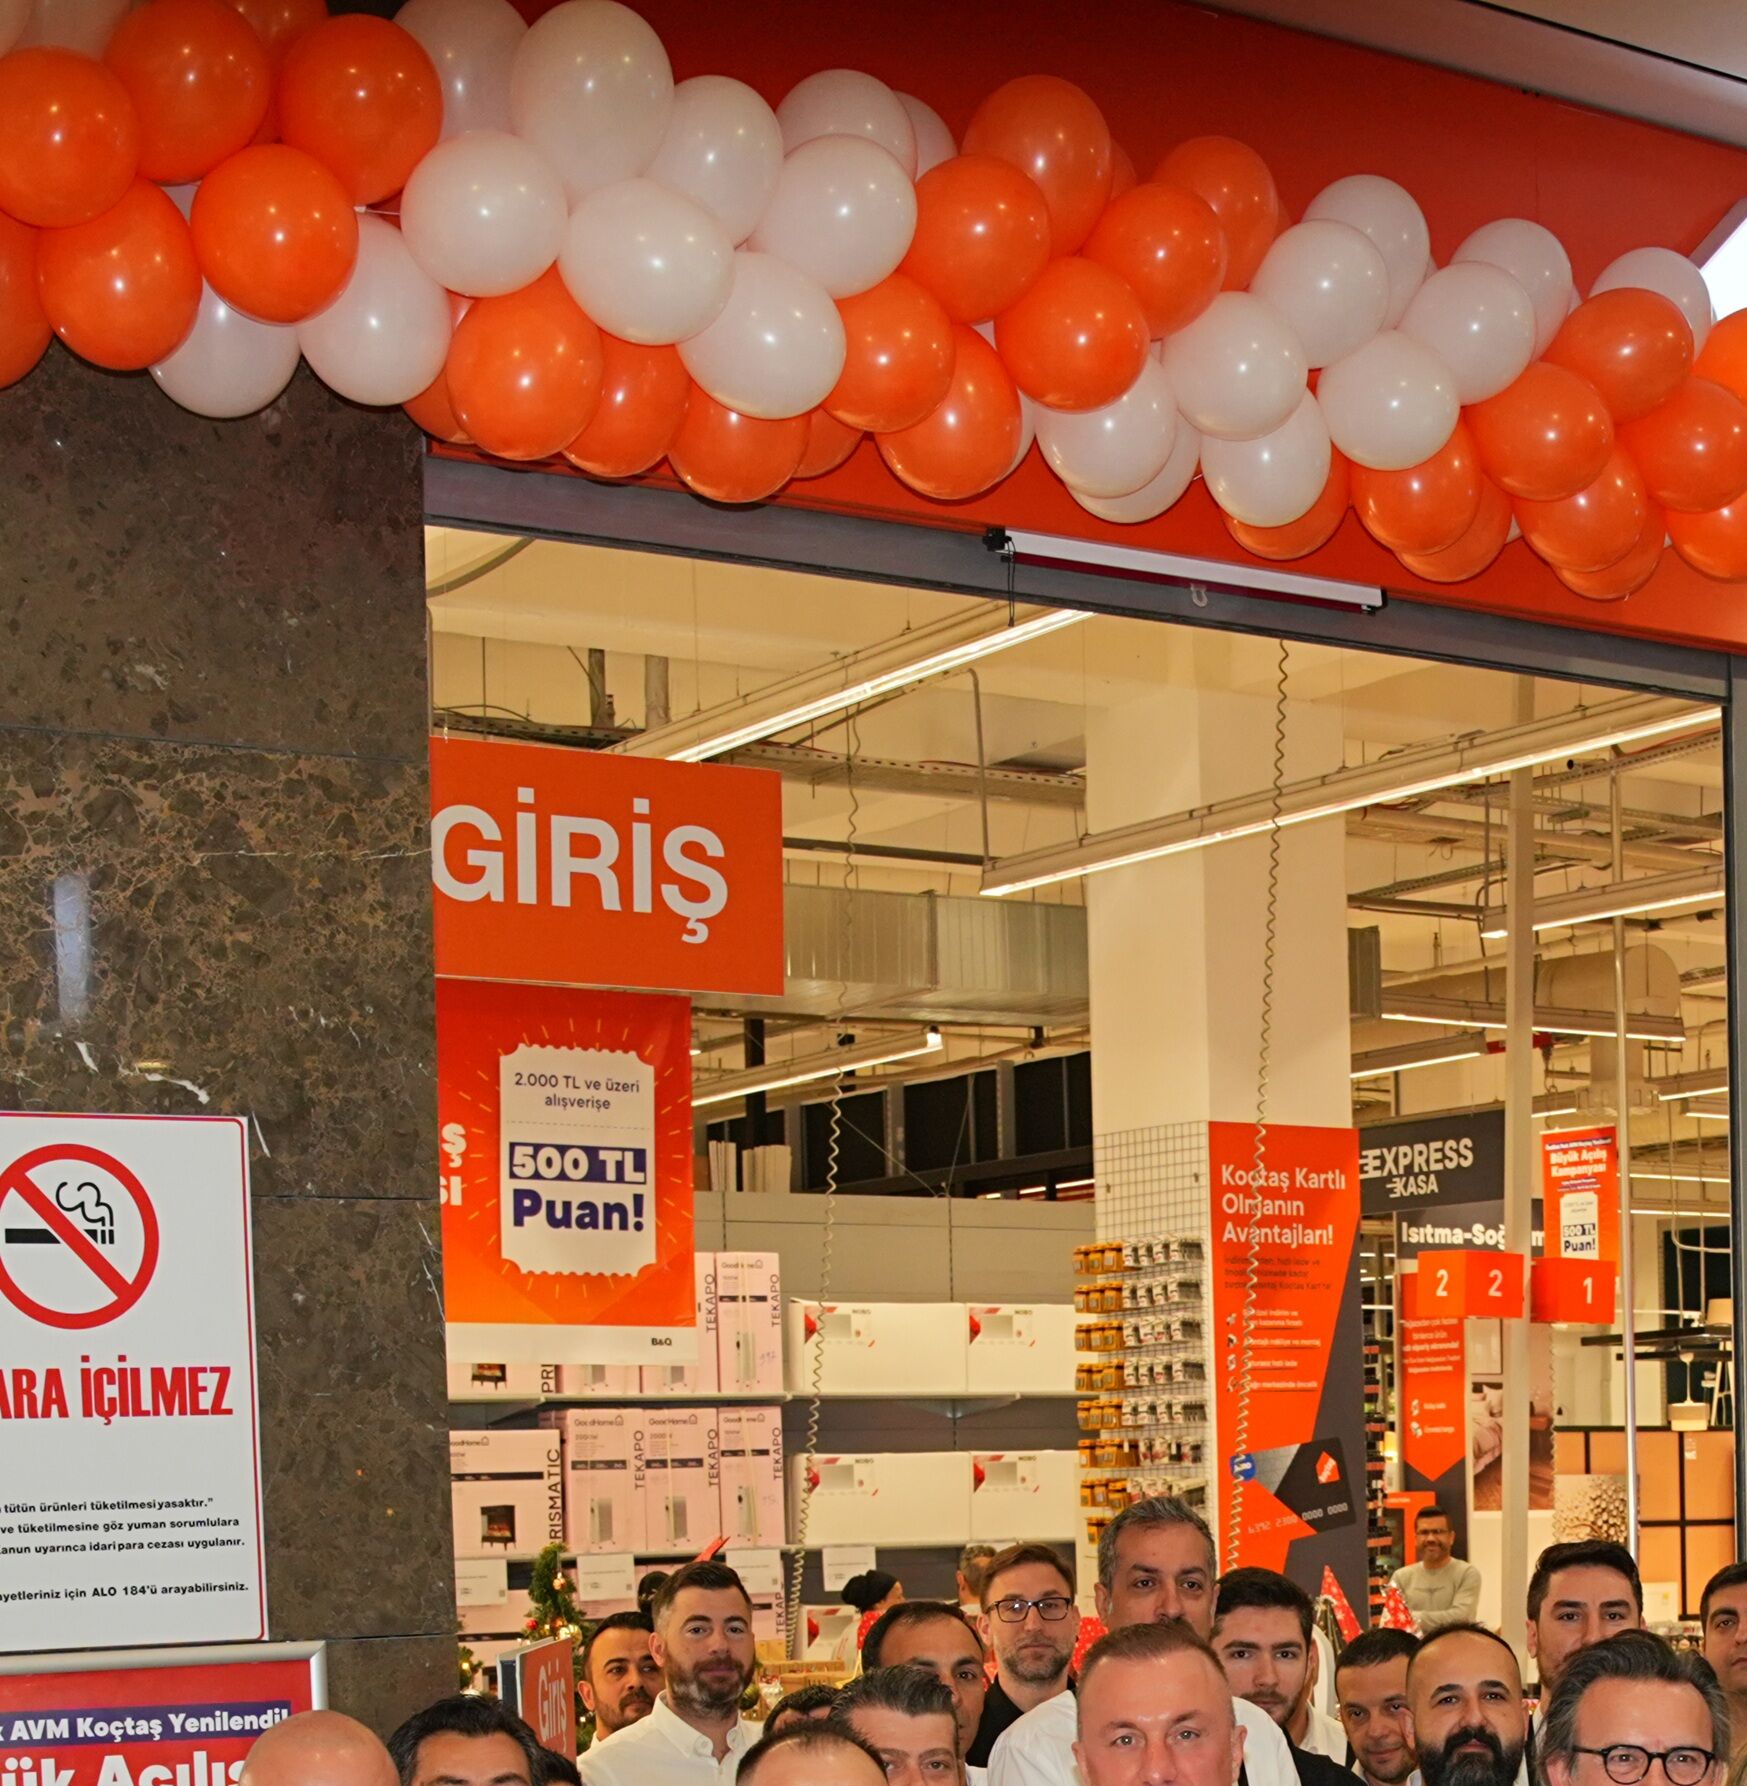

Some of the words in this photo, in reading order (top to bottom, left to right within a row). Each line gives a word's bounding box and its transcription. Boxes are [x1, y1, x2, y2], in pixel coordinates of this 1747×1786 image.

[431, 786, 728, 944] GİRİŞ
[514, 1072, 559, 1088] 2.000
[563, 1075, 580, 1090] TL
[584, 1080, 601, 1091] ve
[605, 1079, 640, 1093] üzeri
[544, 1095, 611, 1112] alışverişe
[512, 1145, 589, 1180] 500
[598, 1149, 645, 1183] TL
[1360, 1138, 1474, 1181] EXPRESS
[1295, 1167, 1346, 1190] Kartlı
[1386, 1174, 1439, 1198] KASA
[512, 1188, 644, 1232] Puan!
[1221, 1221, 1334, 1249] Avantajları!
[1564, 1238, 1596, 1252] Puan!
[1436, 1269, 1449, 1296] 2
[1488, 1269, 1503, 1296] 2
[1583, 1277, 1593, 1304] 1
[704, 1273, 717, 1333] TEKAPO
[770, 1273, 781, 1328] TEKAPO
[651, 1337, 672, 1346] B&Q
[81, 1354, 233, 1426] İÇİLMEZ
[634, 1430, 645, 1490] TEKAPO
[707, 1429, 719, 1488] TEKAPO
[772, 1427, 782, 1480] TEKAPO
[4, 1502, 36, 1513] tütün
[39, 1500, 87, 1512] ürünleri
[546, 1449, 562, 1542] RISMATIC
[18, 1522, 99, 1533] tüketilmesine
[103, 1520, 124, 1533] göz
[127, 1520, 166, 1532] yuman
[170, 1518, 239, 1529] sorumlulara
[0, 1544, 31, 1555] anun
[34, 1543, 87, 1555] uyarınca
[89, 1541, 116, 1551] idari
[117, 1541, 144, 1552] para
[147, 1539, 184, 1550] cezası
[187, 1537, 245, 1550] uygulanır.
[64, 1588, 87, 1600] için
[92, 1586, 117, 1597] ALO
[123, 1584, 157, 1596] 184'ü
[161, 1581, 249, 1595] arayabilirsiniz.
[775, 1588, 785, 1635] TEKAP
[10, 1718, 69, 1741] AVM
[77, 1716, 163, 1742] Koçtaş
